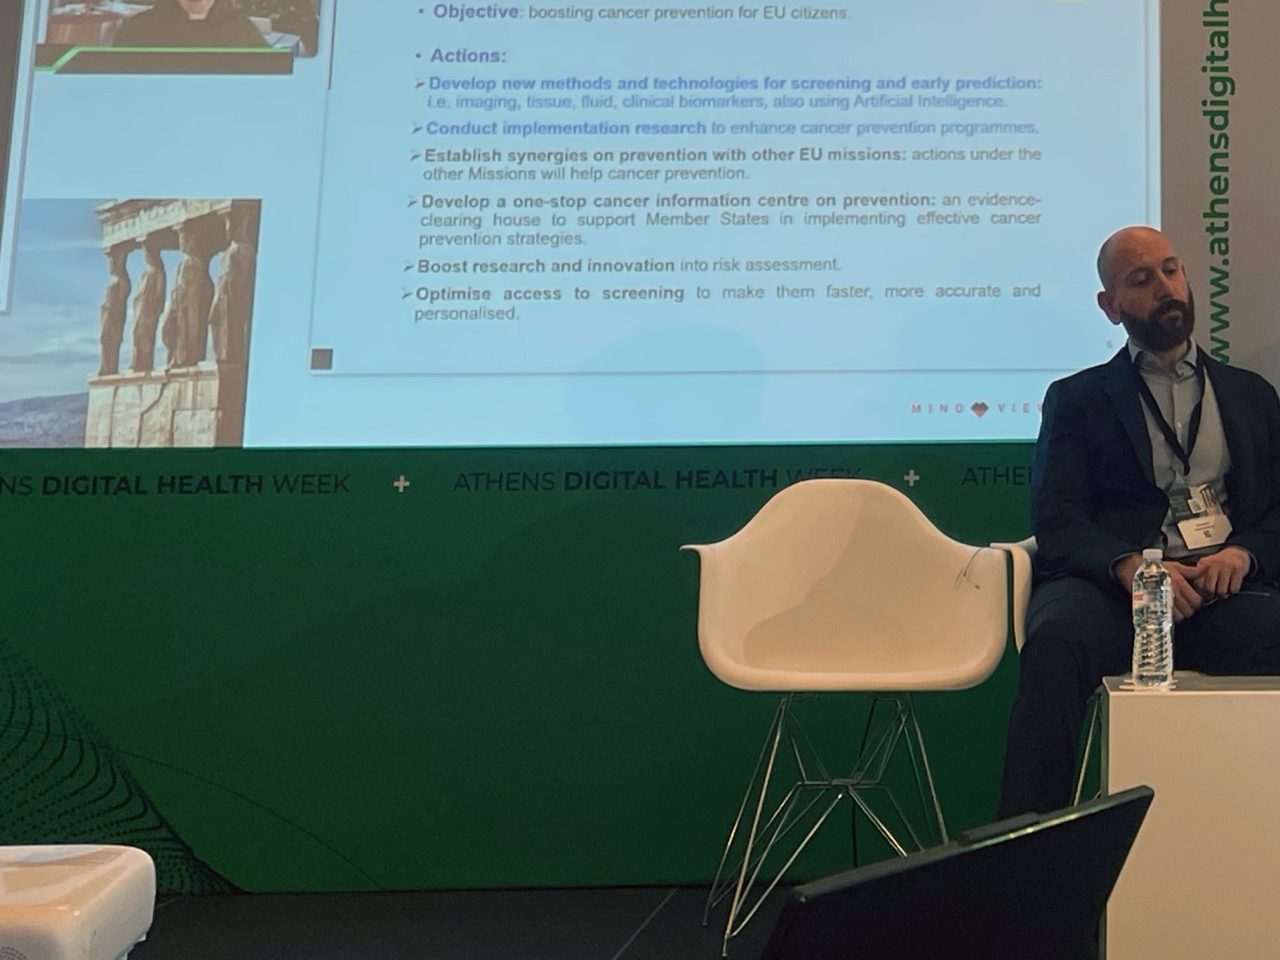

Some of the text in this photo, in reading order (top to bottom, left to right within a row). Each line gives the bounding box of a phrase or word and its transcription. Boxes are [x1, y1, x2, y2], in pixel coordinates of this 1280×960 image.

[433, 3, 852, 23] Objective: boosting cancer prevention for EU citizens.
[430, 48, 507, 64] Actions:
[428, 76, 1043, 93] Develop new methods and technologies for screening and early prediction:
[424, 147, 1042, 166] Establish synergies on prevention with other EU missions: actions under the
[421, 194, 1042, 212] Develop a one-stop cancer information centre on prevention: an evidence-
[419, 232, 587, 249] prevention strategies.
[418, 258, 842, 273] Boost research and innovation into risk assessment.
[414, 307, 520, 323] personalised.
[911, 403, 964, 413] MIND
[41, 475, 148, 496] DIGITAL
[157, 474, 265, 495] HEALTH
[272, 473, 351, 494] WEEK
[453, 471, 556, 492] ATHENS
[564, 470, 668, 491] DIGITAL
[674, 468, 779, 489] HEALTH
[961, 466, 1032, 486] ATHE
